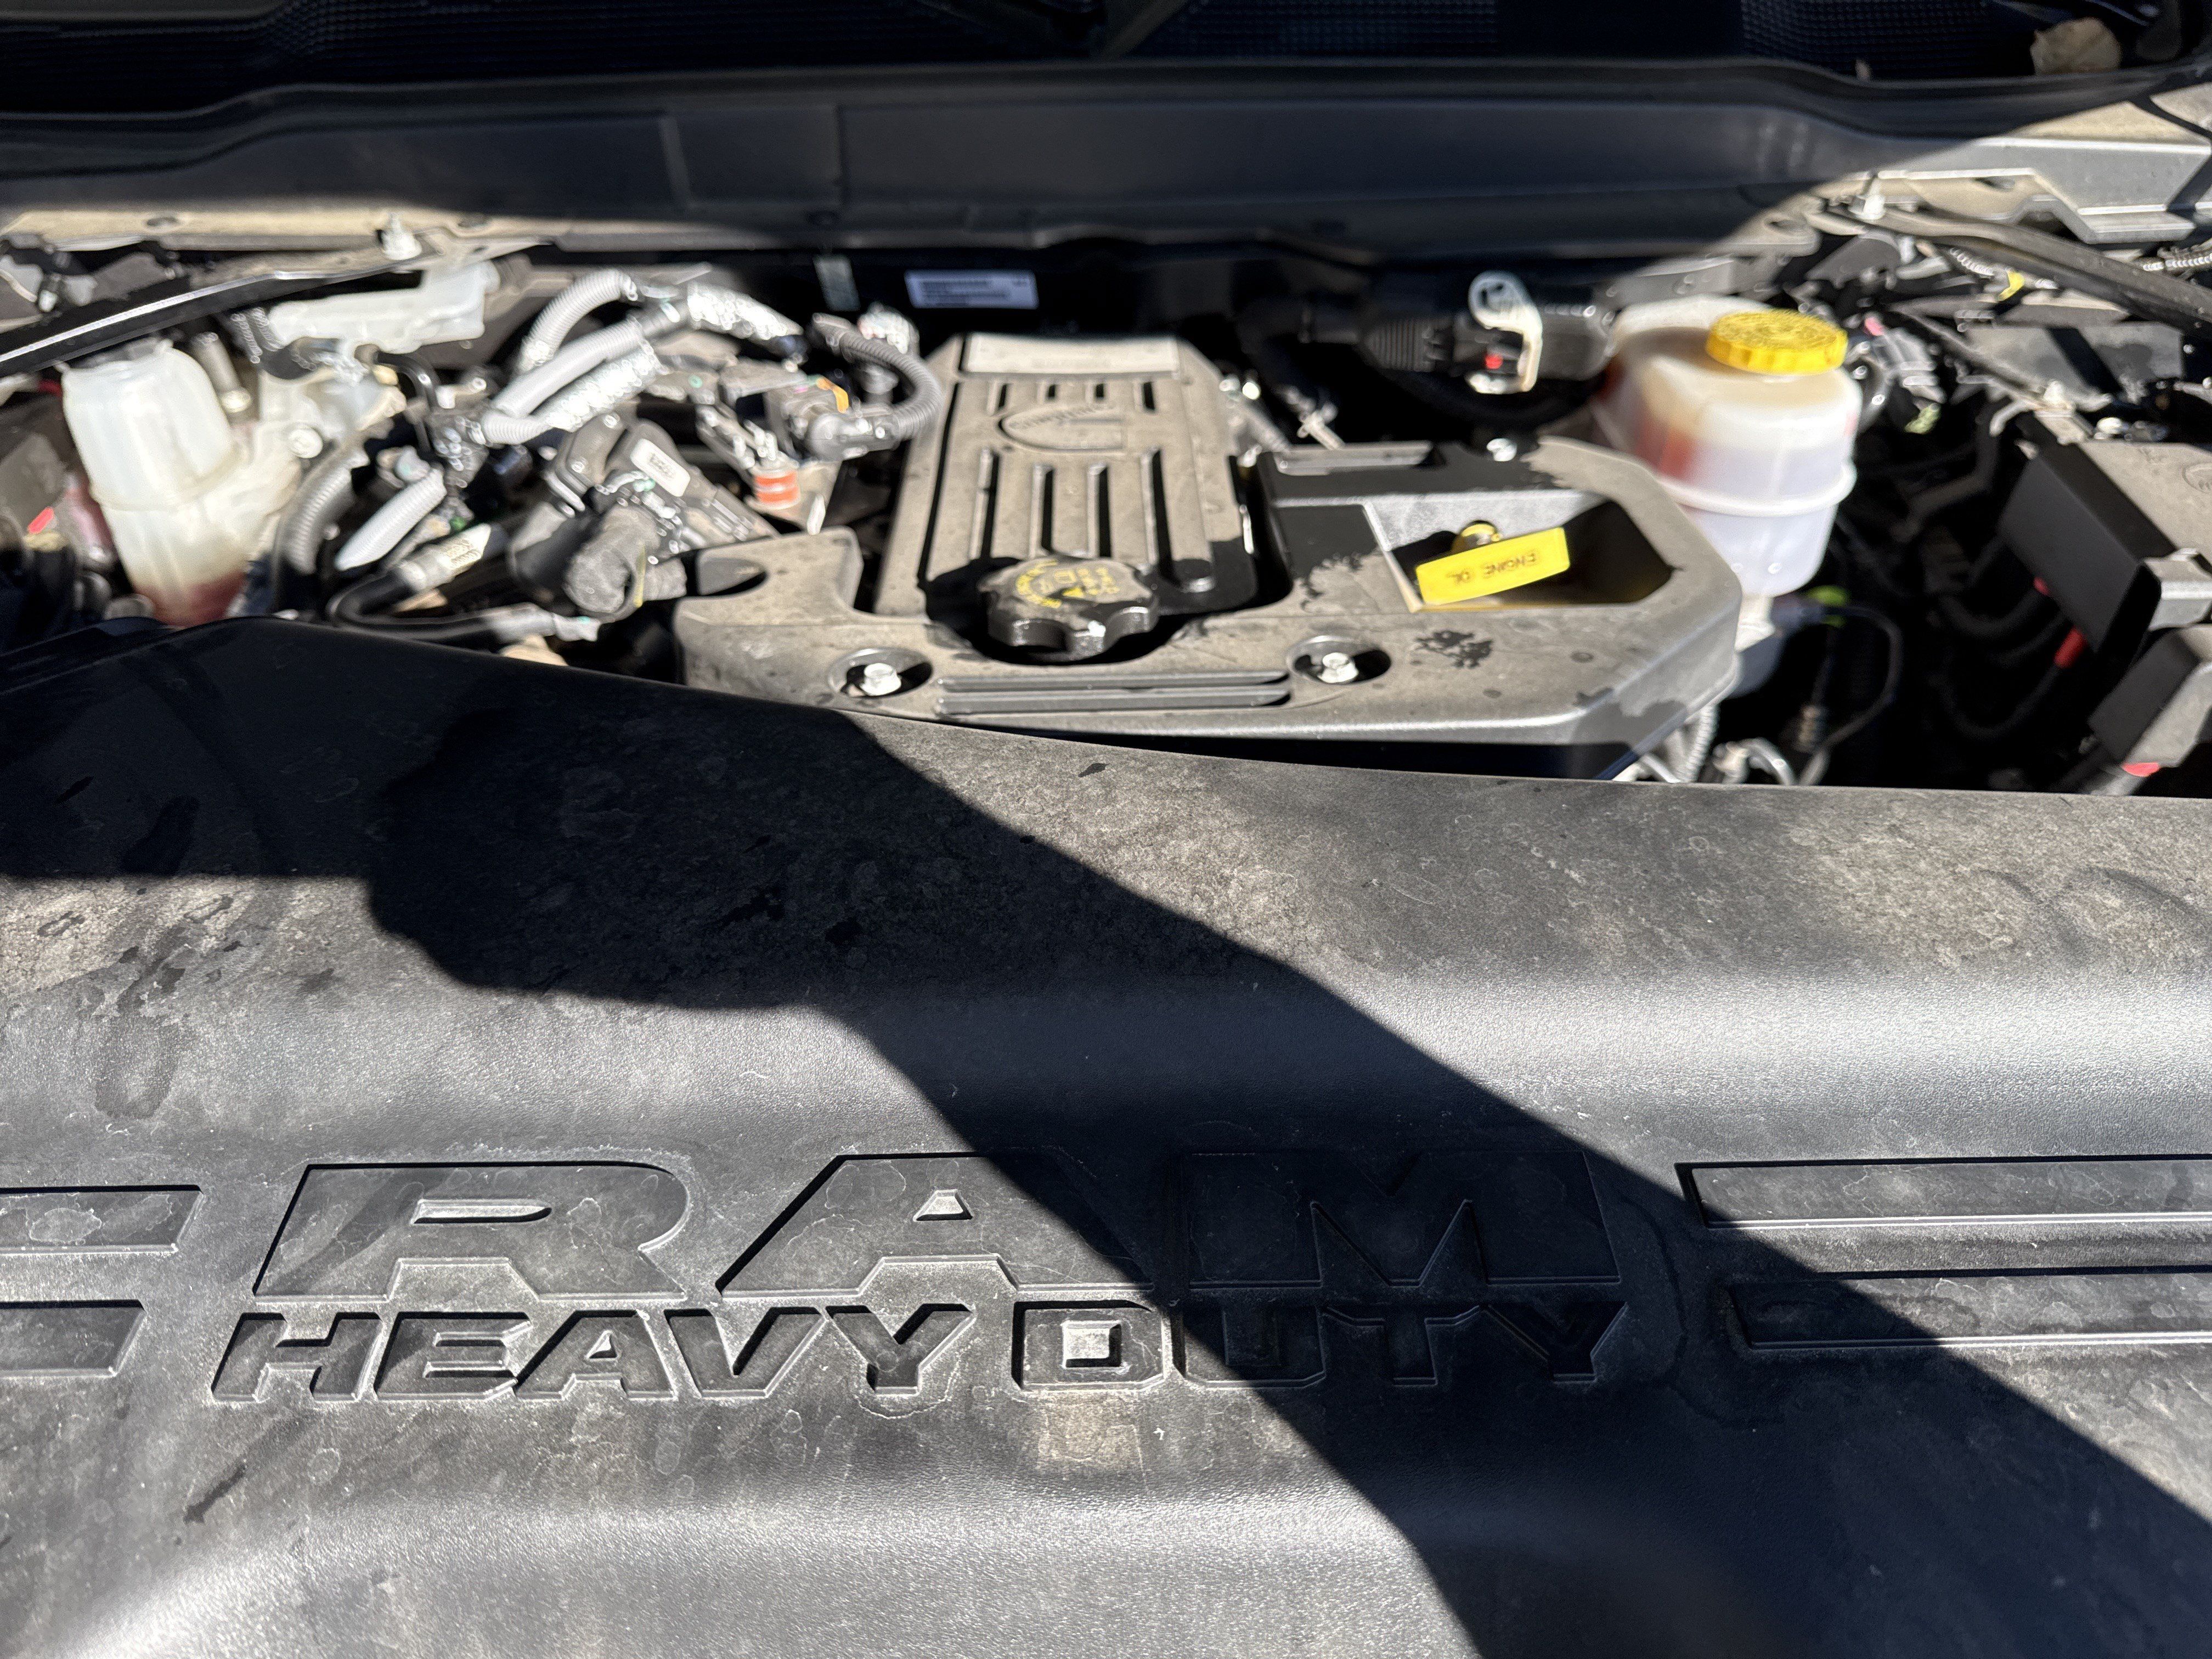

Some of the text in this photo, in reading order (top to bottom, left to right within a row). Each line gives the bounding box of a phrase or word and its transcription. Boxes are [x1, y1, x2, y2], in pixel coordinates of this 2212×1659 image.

[251, 1148, 1622, 1304] RAM
[211, 1298, 1628, 1402] HEAVY DUTY
